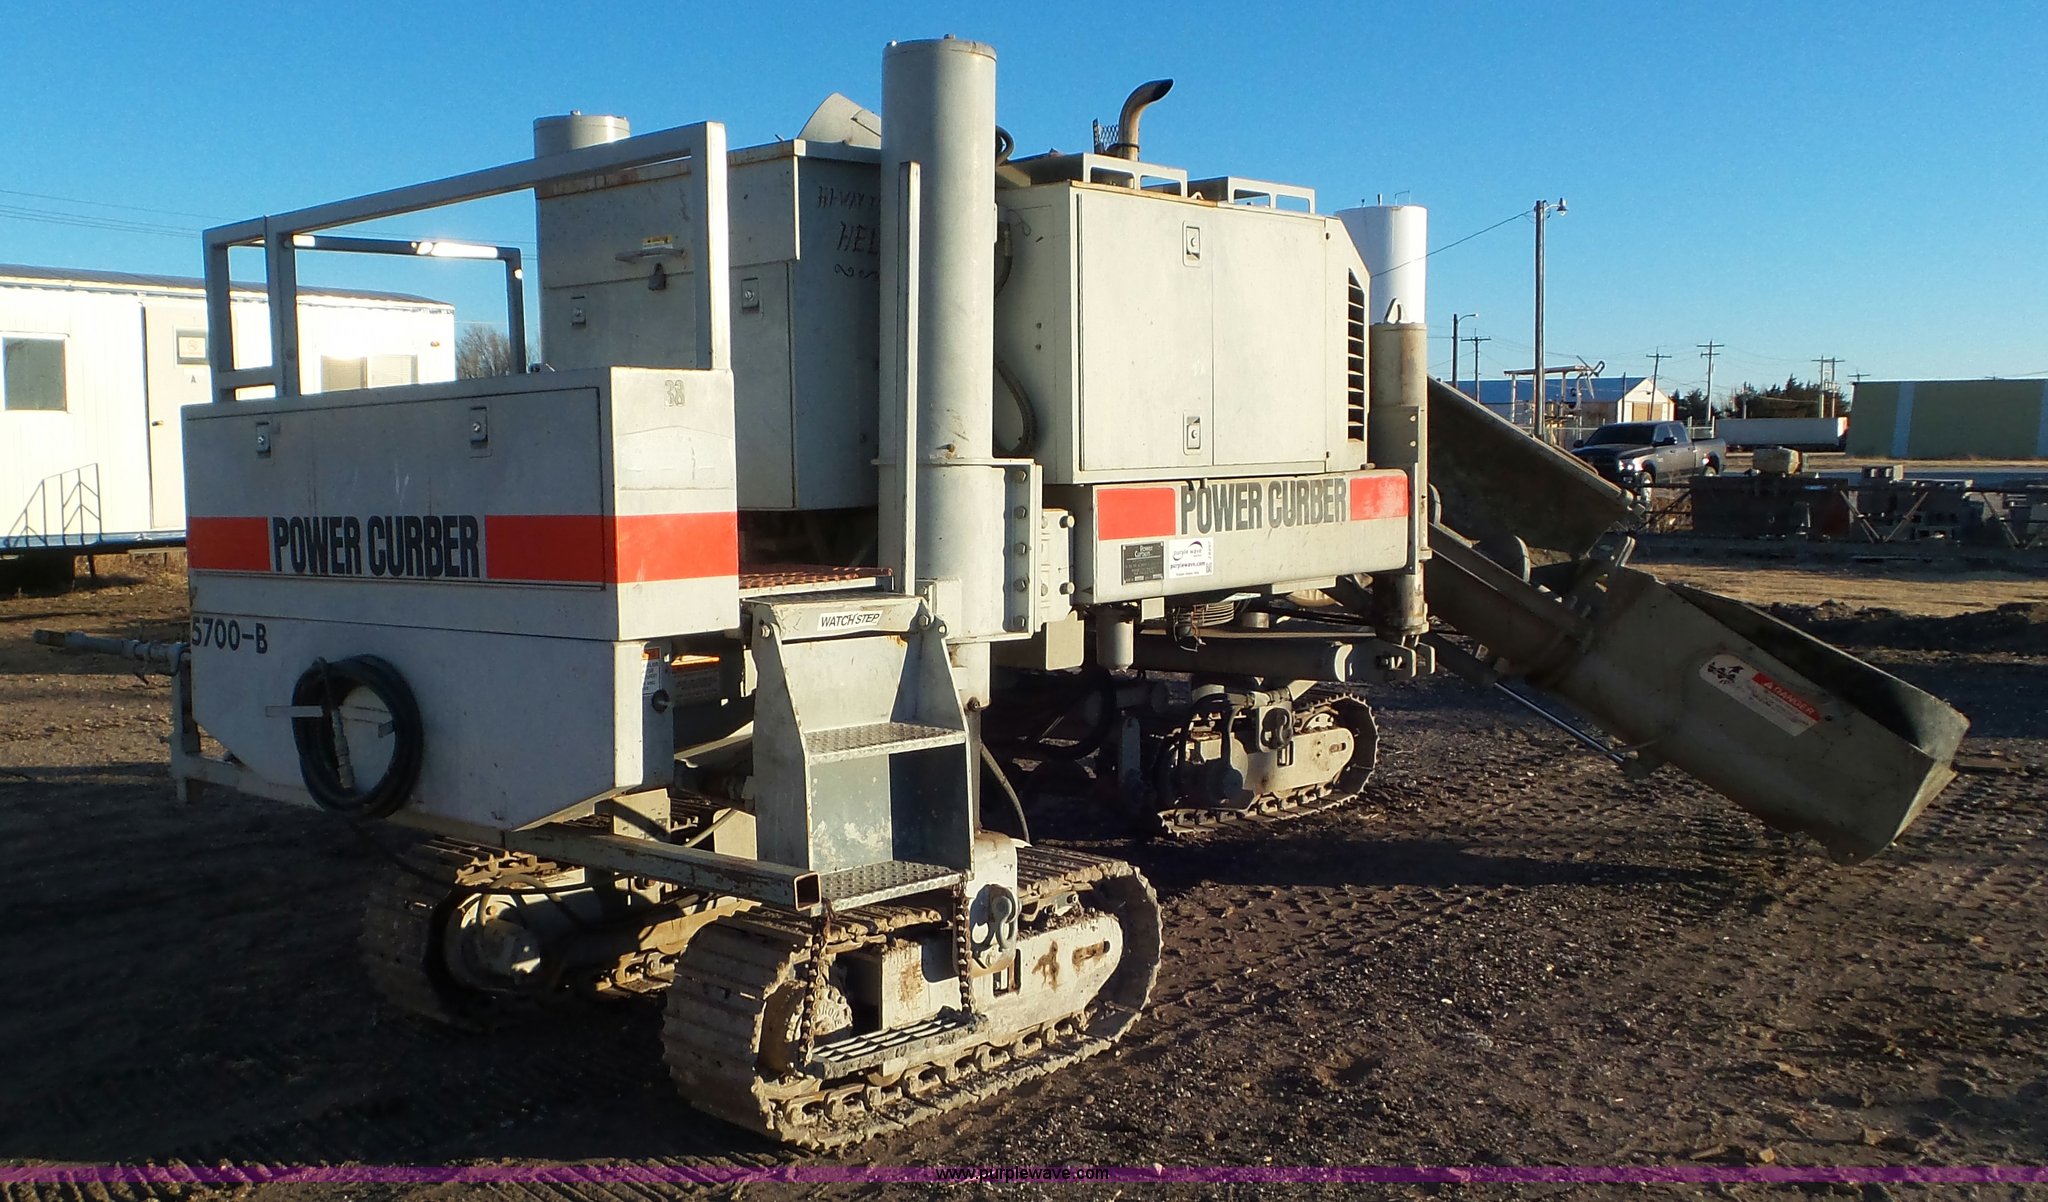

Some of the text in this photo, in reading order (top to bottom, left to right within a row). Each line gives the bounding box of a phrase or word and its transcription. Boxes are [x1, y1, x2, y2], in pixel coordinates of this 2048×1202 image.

[190, 374, 197, 384] A
[1181, 478, 1347, 535] POWER CURBER
[272, 515, 480, 578] POWER CURBER
[191, 618, 268, 654] 5700-B
[821, 613, 880, 627] WATCH STEP
[1774, 686, 1815, 715] DANGER
